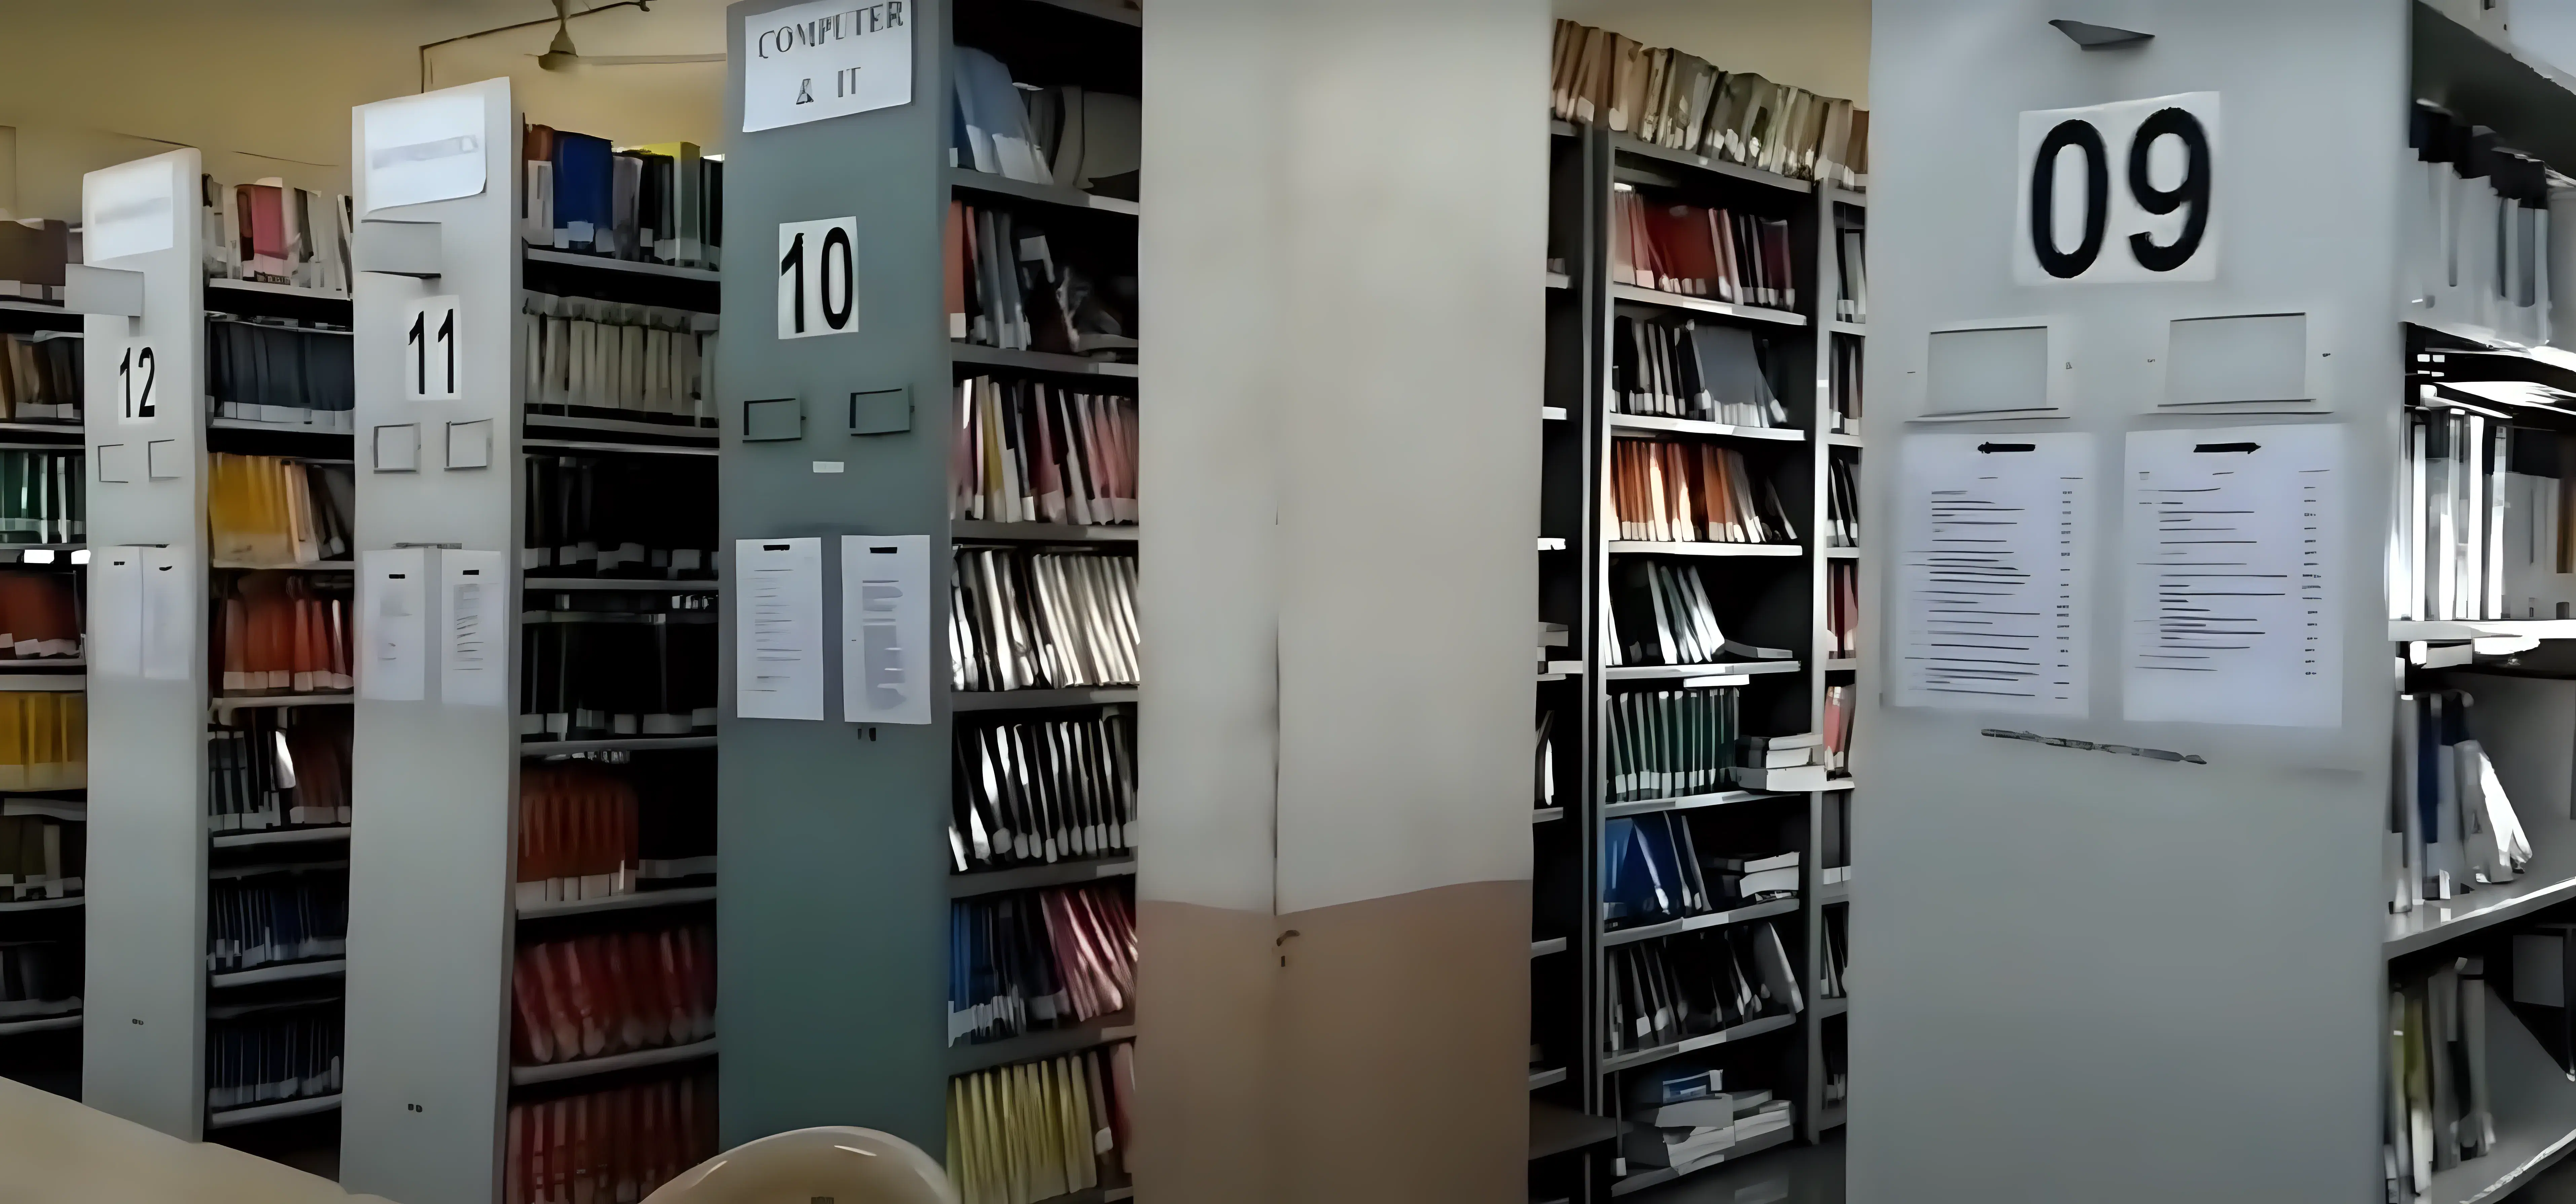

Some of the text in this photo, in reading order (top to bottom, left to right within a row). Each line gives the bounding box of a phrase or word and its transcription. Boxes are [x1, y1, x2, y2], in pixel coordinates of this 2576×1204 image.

[759, 1, 904, 59] COMPUTER
[837, 67, 861, 98] IT
[2031, 106, 2211, 279] 09
[781, 227, 853, 334] 10
[120, 346, 155, 418] 12
[408, 308, 454, 394] 11
